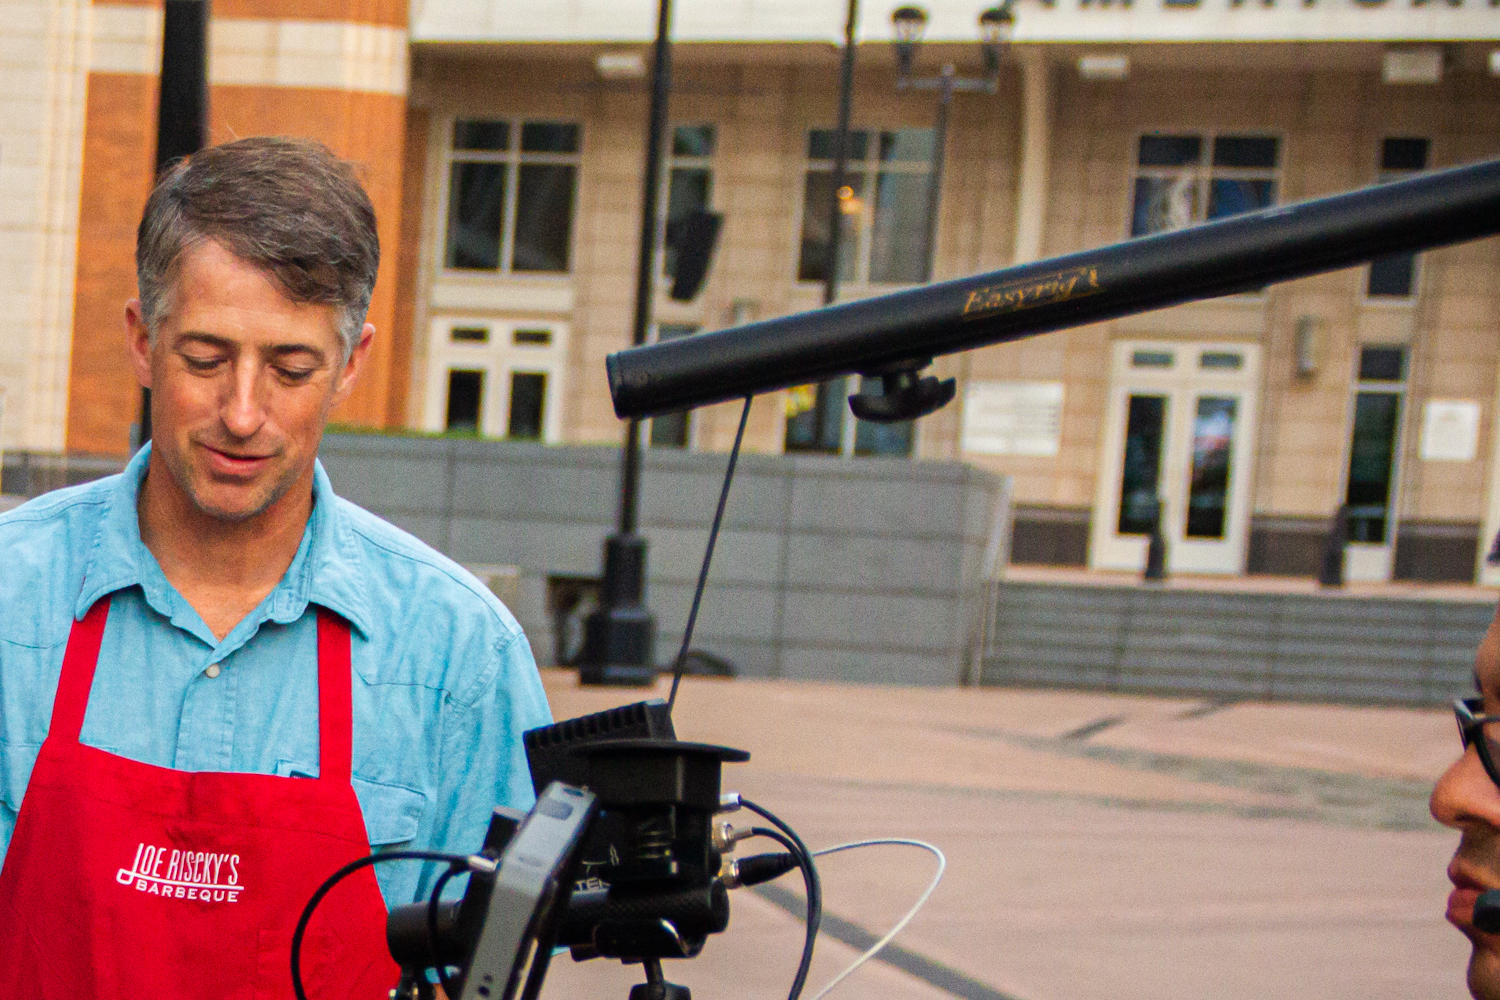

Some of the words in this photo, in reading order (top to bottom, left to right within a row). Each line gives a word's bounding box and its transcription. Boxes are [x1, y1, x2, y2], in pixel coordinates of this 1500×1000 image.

[116, 842, 167, 885] JOE
[166, 848, 241, 886] RISCKY'S
[135, 879, 240, 903] BARBEQUE
